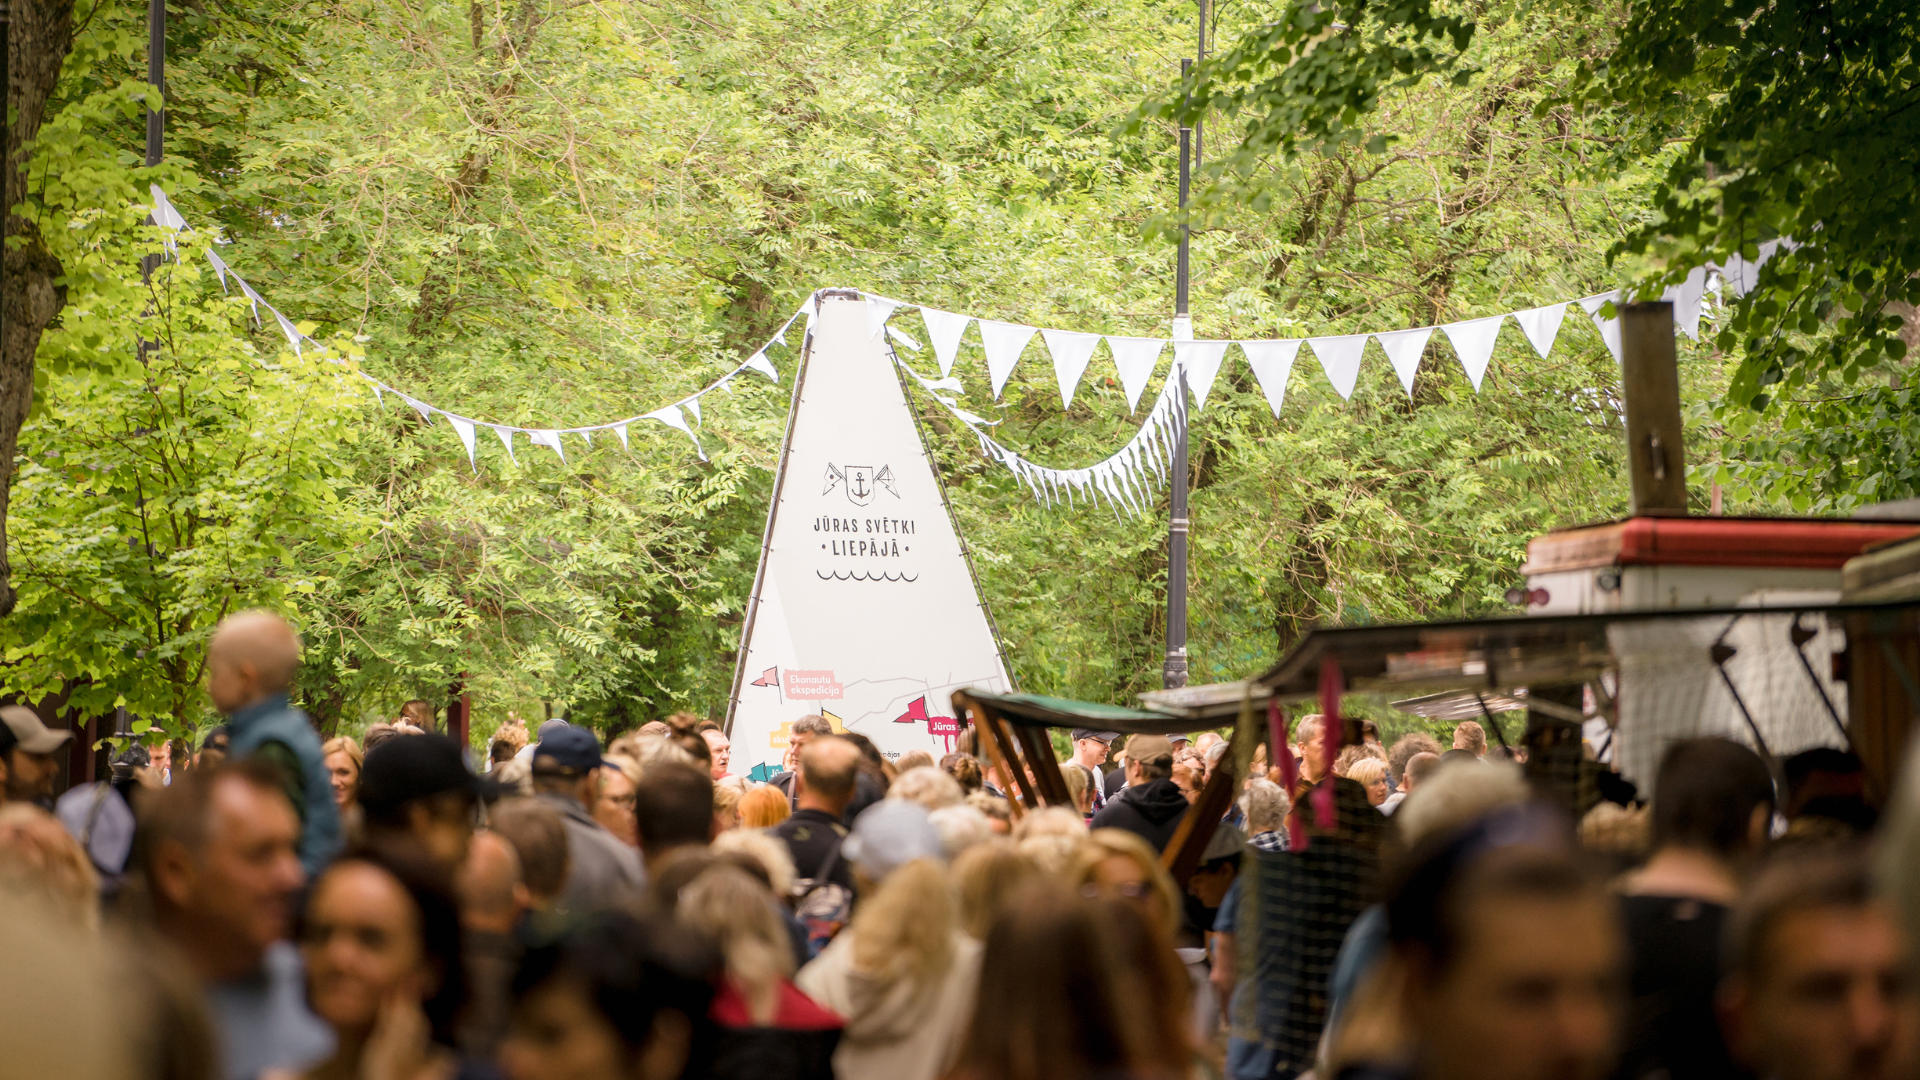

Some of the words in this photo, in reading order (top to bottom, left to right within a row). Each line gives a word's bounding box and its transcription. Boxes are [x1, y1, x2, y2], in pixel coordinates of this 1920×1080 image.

[814, 515, 858, 533] JŪRAS
[866, 517, 915, 534] SVĒTKI
[832, 538, 900, 557] LIEPĀJĀ
[790, 675, 831, 684] Ekonautu
[791, 685, 840, 697] ekspedīcija
[932, 721, 956, 731] Jūras
